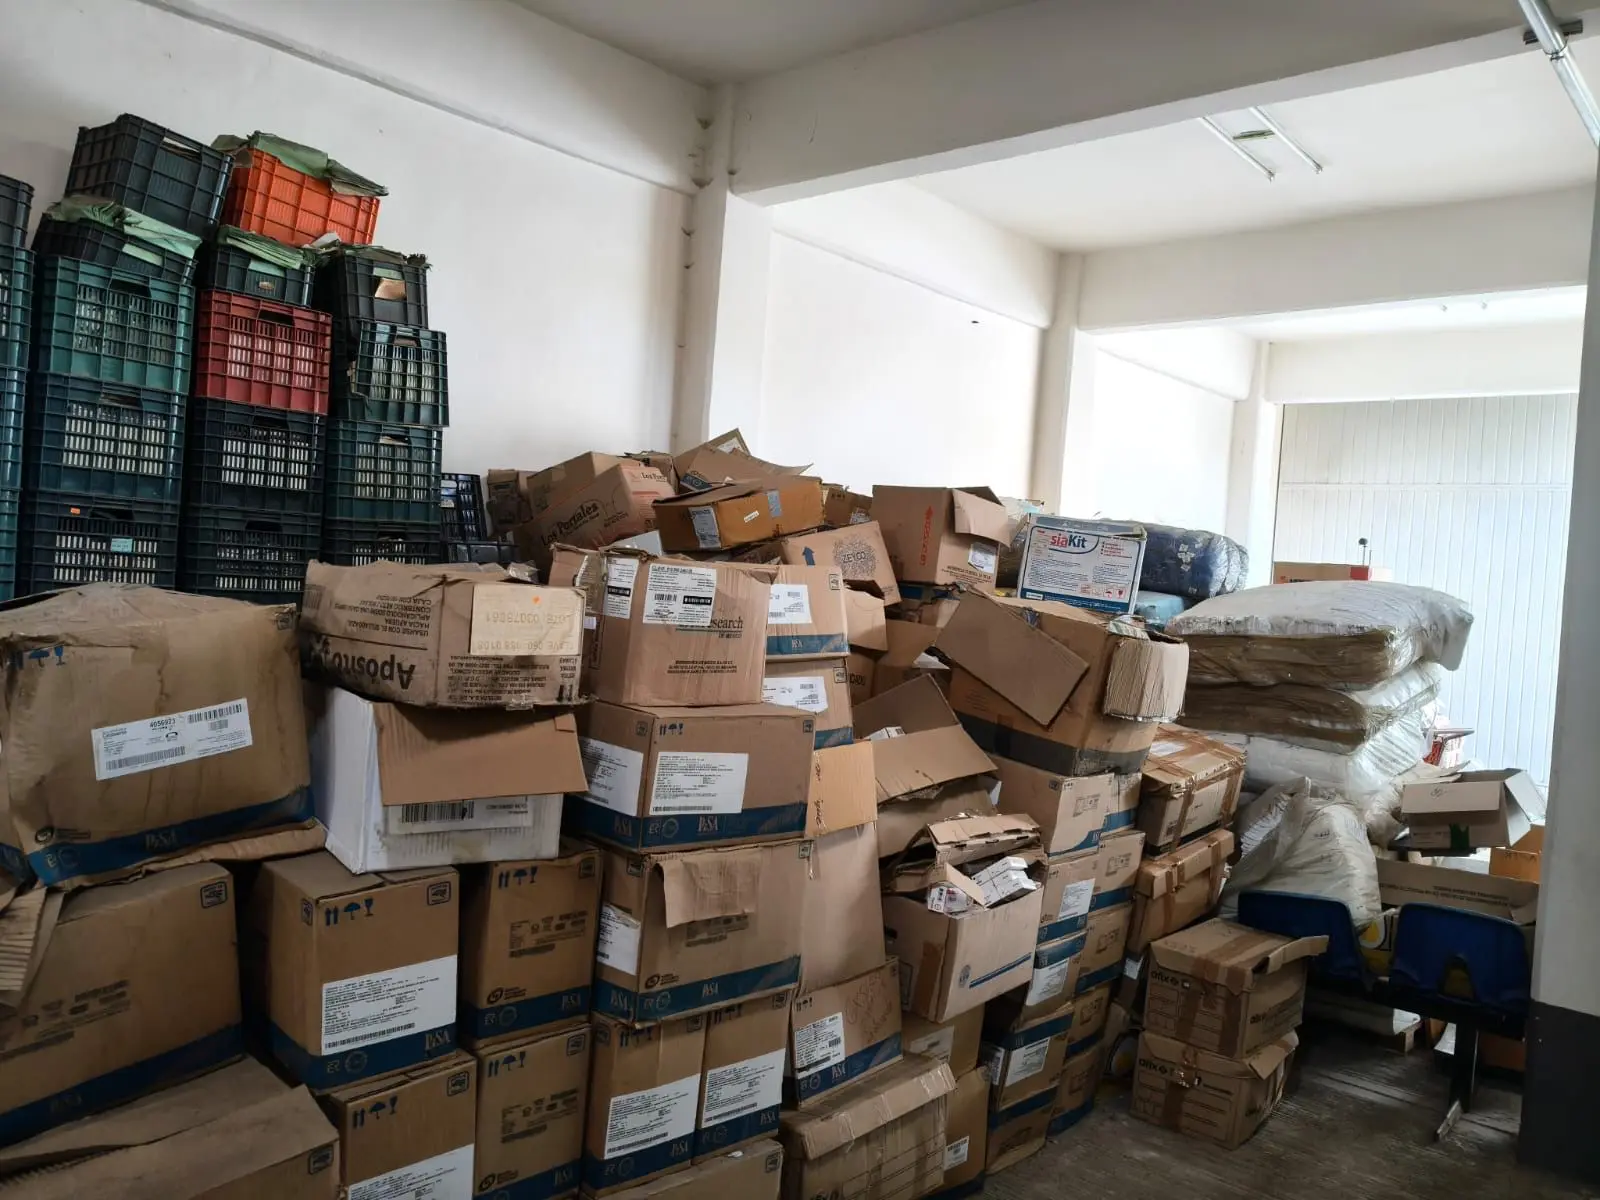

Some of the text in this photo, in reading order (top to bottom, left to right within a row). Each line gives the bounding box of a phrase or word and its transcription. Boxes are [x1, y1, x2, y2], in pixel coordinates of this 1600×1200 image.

[557, 501, 600, 534] Portales
[1050, 533, 1088, 549] siaKit
[841, 551, 867, 563] ZEYCO
